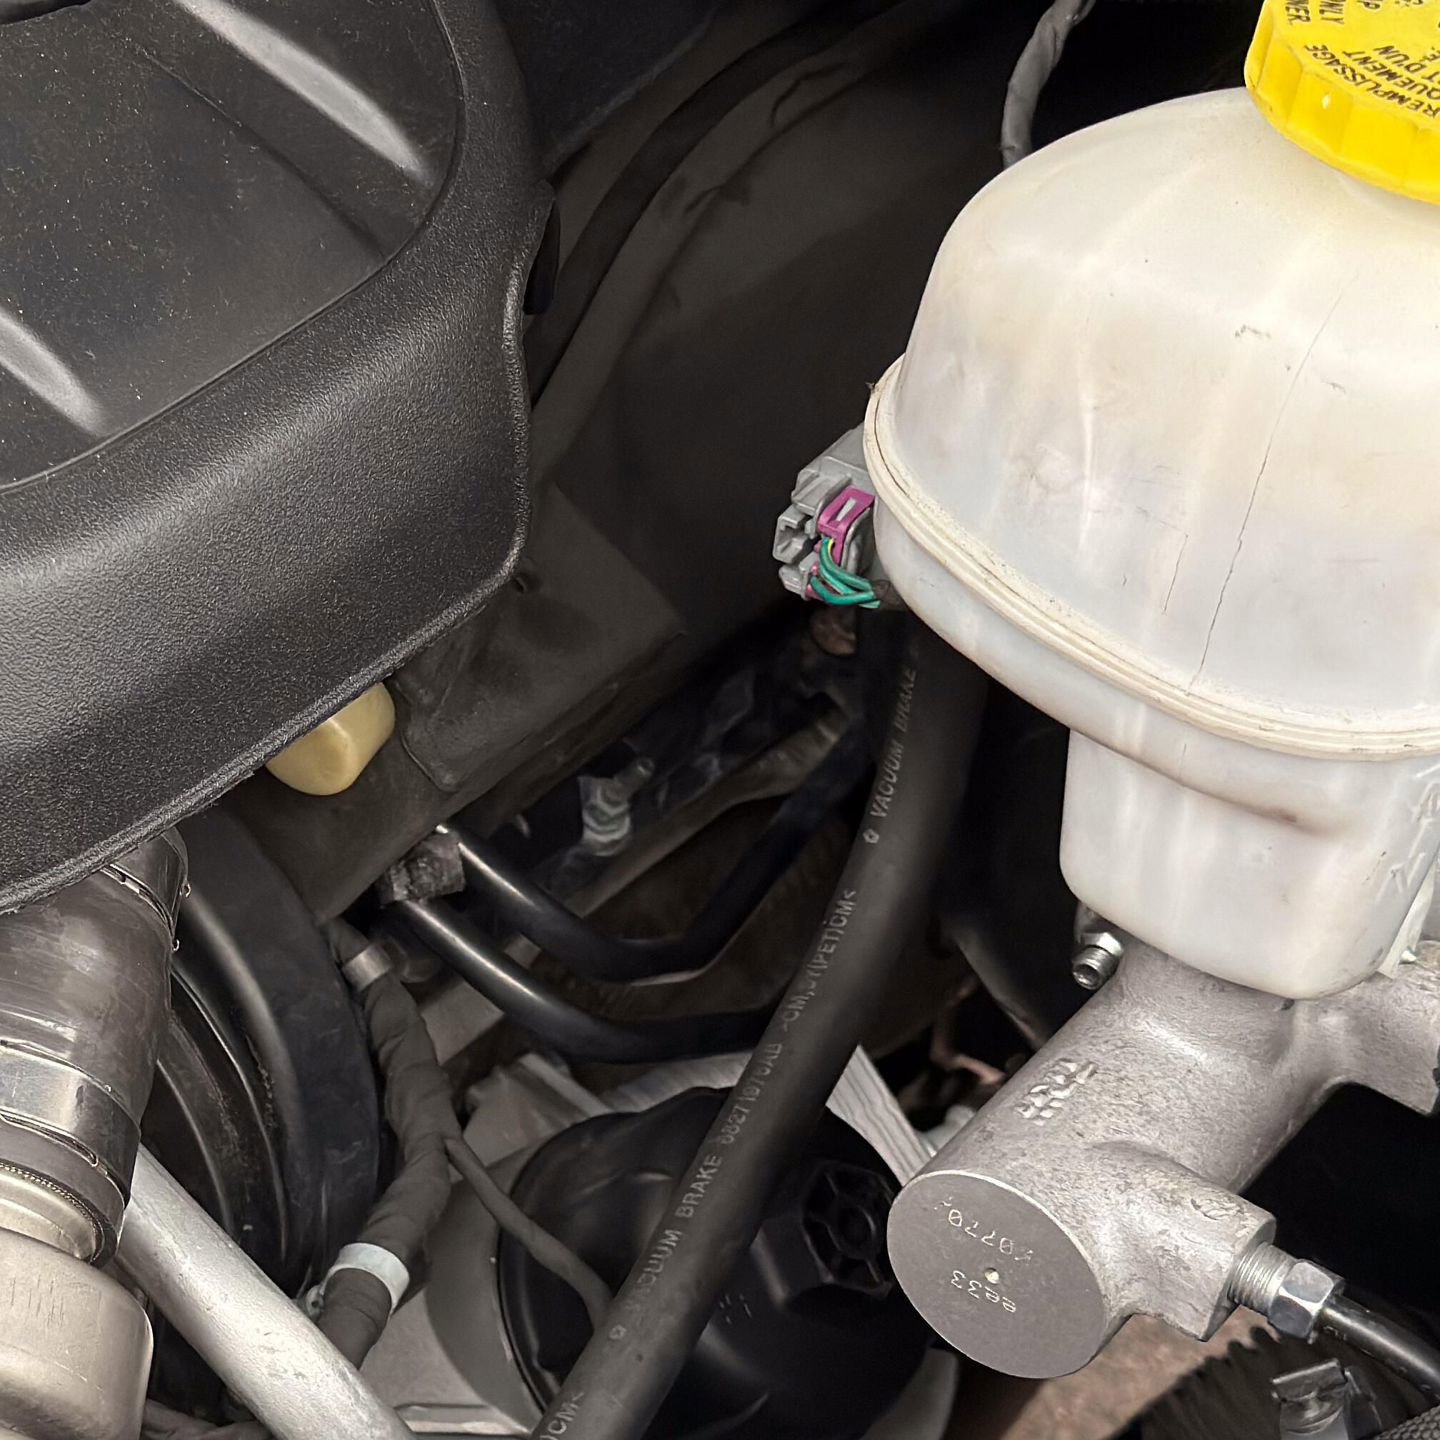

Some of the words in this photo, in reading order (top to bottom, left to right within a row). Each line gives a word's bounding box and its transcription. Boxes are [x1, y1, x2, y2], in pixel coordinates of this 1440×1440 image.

[1304, 44, 1440, 118] REMPLISSAGE
[868, 740, 905, 819] VACUUM
[892, 664, 920, 737] BRAKE
[676, 1152, 725, 1226] BRAKE
